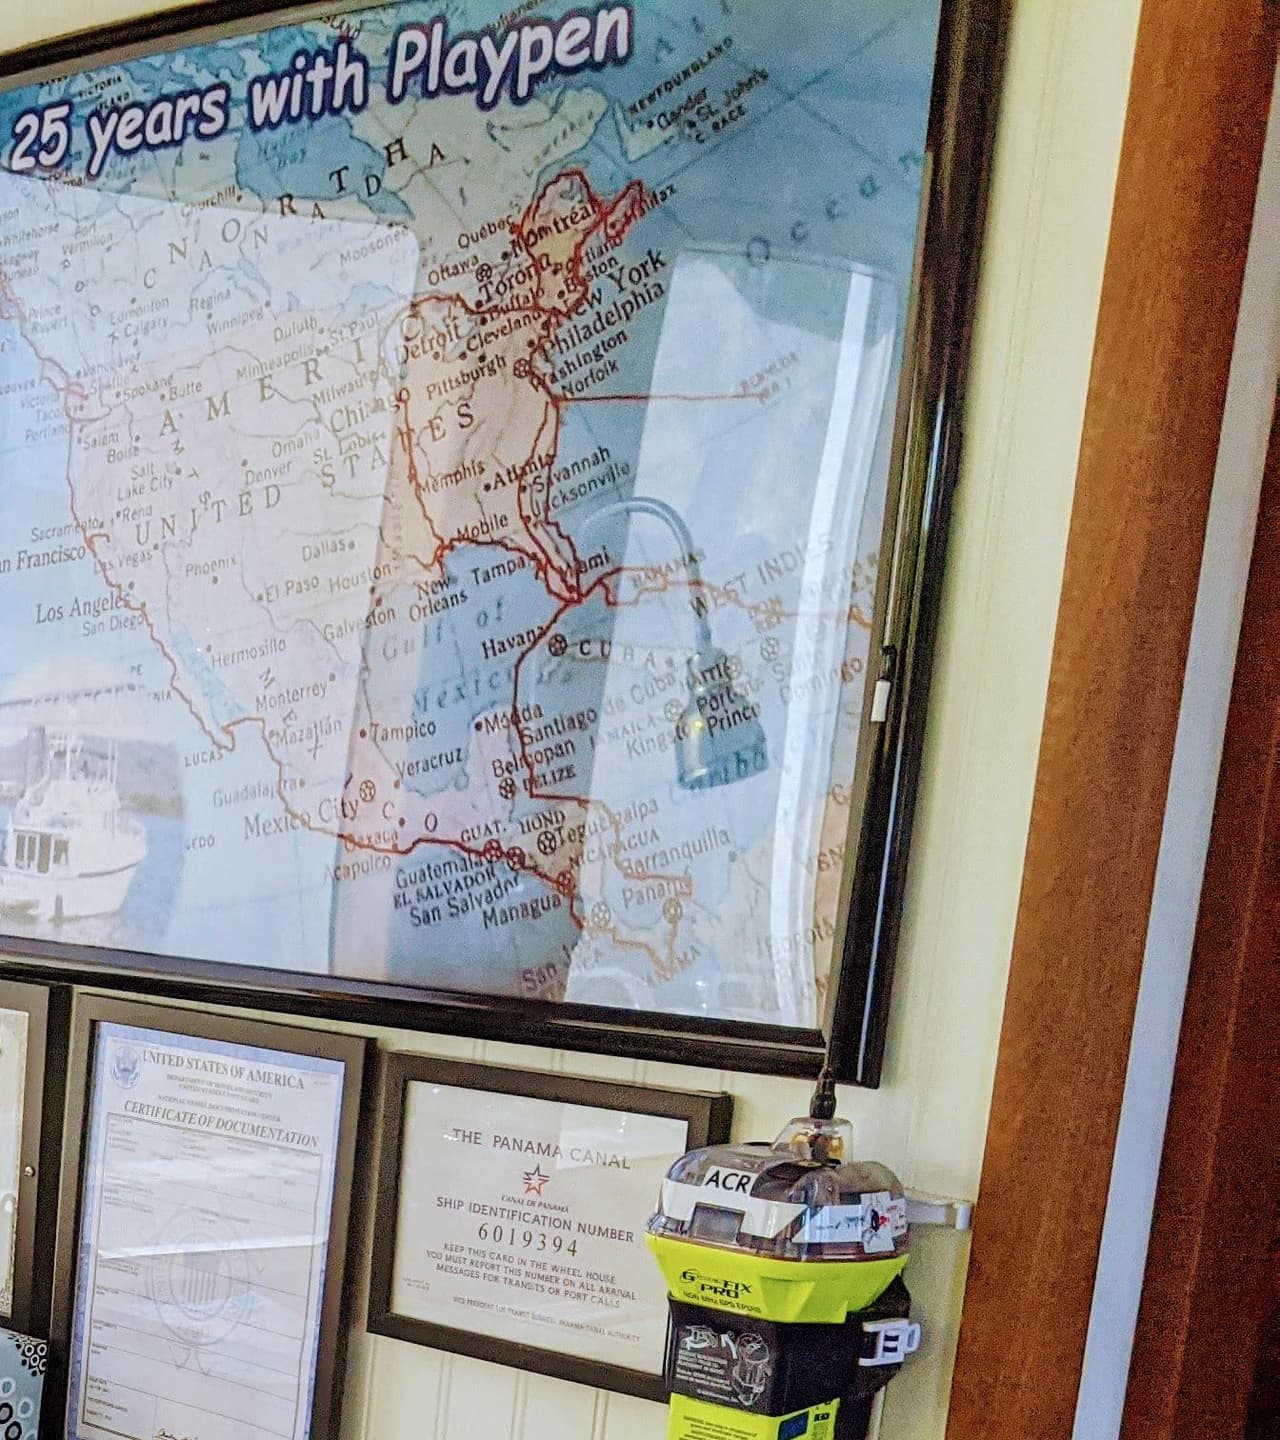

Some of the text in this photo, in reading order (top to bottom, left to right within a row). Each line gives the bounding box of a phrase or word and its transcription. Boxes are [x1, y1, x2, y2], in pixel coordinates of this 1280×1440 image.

[11, 104, 70, 171] 25
[86, 87, 230, 176] years
[252, 47, 365, 125] with
[392, 5, 628, 111] Playpen
[428, 255, 479, 286] Ottawa
[608, 250, 666, 293] York
[207, 307, 264, 337] Winnipeg
[466, 310, 542, 354] Cleveland
[541, 281, 665, 362] Philadelphia
[399, 323, 461, 364] Detroit
[427, 354, 508, 401] Pittsburgh
[531, 330, 628, 394] Washington
[561, 358, 620, 401] Norfolk
[456, 512, 509, 540] Mobile
[17, 544, 87, 572] Francisco
[185, 554, 238, 578] Phoenix
[302, 538, 348, 563] Dallas
[285, 576, 321, 598] Paso
[329, 562, 392, 594] Houston
[416, 576, 452, 600] New
[471, 557, 527, 588] Tampa
[35, 602, 65, 625] Los
[409, 590, 468, 622] Orleans
[323, 607, 396, 643] Galveston
[212, 637, 288, 668] Hermosillo
[256, 683, 329, 713] Monterrey
[370, 720, 437, 743] Tampico
[522, 708, 598, 747] Santiago
[394, 747, 464, 783] Veracruz
[318, 796, 359, 824] City
[324, 852, 392, 883] Acapulco
[416, 864, 496, 900] SALVADOR
[410, 876, 522, 928] San Salvador
[483, 893, 563, 931] Managua
[142, 1049, 306, 1091] UNITED STATES OF AMERICA
[124, 1099, 197, 1125] CERTIFICATE
[198, 1114, 216, 1128] OF
[217, 1117, 320, 1148] DOCUMENTATION
[452, 1128, 632, 1170] THE PANAMA CANAL
[705, 1168, 752, 1195] ACR
[436, 1196, 635, 1244] SHIP IDENTIFICATION NUMBER
[477, 1221, 579, 1258] 6019394
[426, 1250, 638, 1301] YOU MUST REPORT THIS NUMBER ON ALL ARRIVAL
[443, 1242, 618, 1285] KEEP THIS CARD IN THE WHEEL HOUSE
[436, 1263, 621, 1310] MESSAGES FOR TRANSITS OR PORT CALLS
[700, 1283, 739, 1299] PRO
